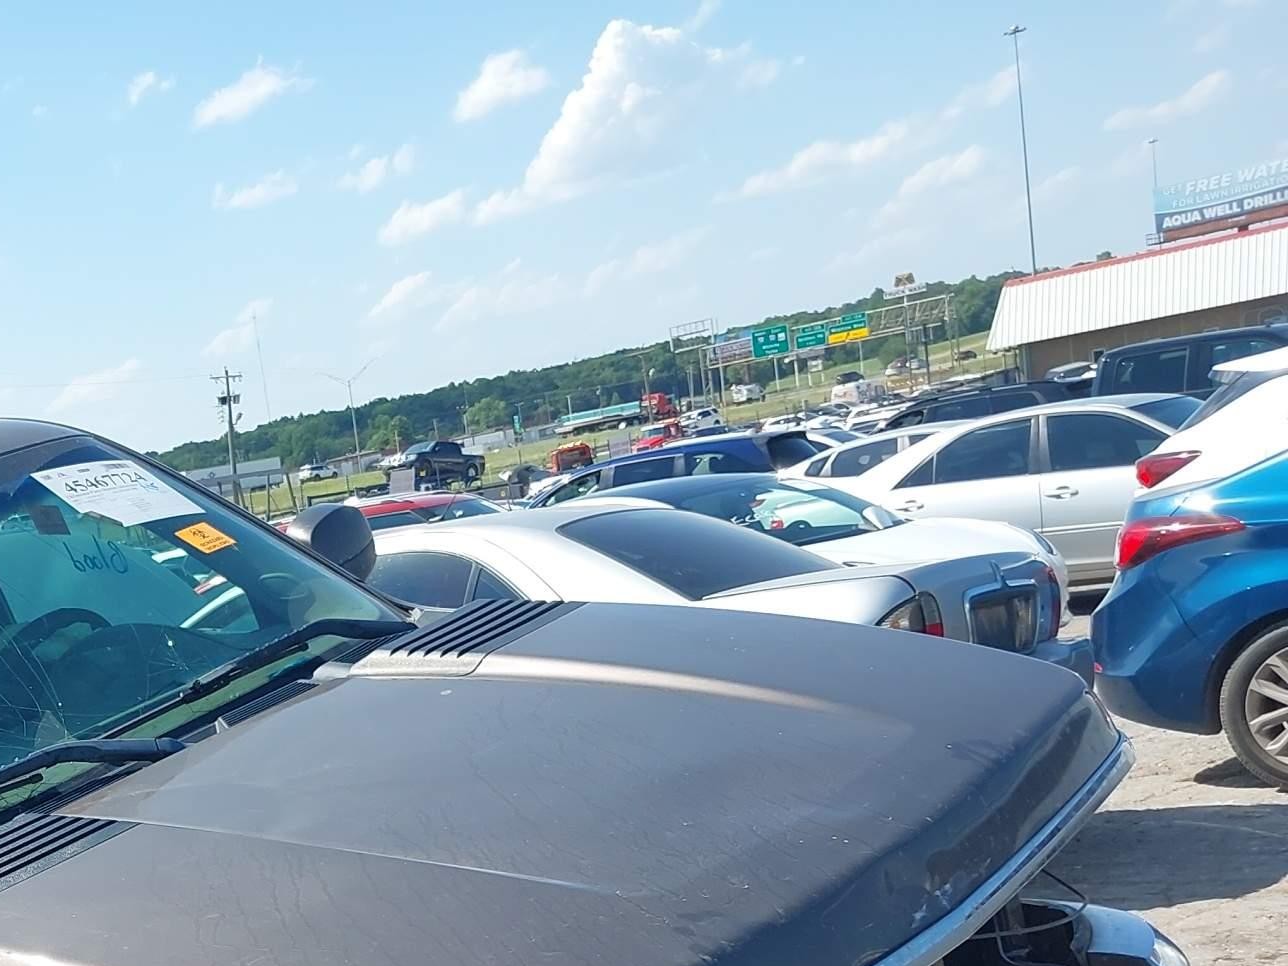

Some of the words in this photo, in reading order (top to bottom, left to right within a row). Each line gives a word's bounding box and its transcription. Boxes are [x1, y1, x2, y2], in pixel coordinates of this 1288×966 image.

[1185, 173, 1233, 197] FREE
[1172, 197, 1195, 209] FOR
[1196, 189, 1229, 204] LAWN
[1162, 211, 1201, 229] AQUA
[1202, 202, 1241, 219] WELL
[64, 471, 146, 494] 45467724
